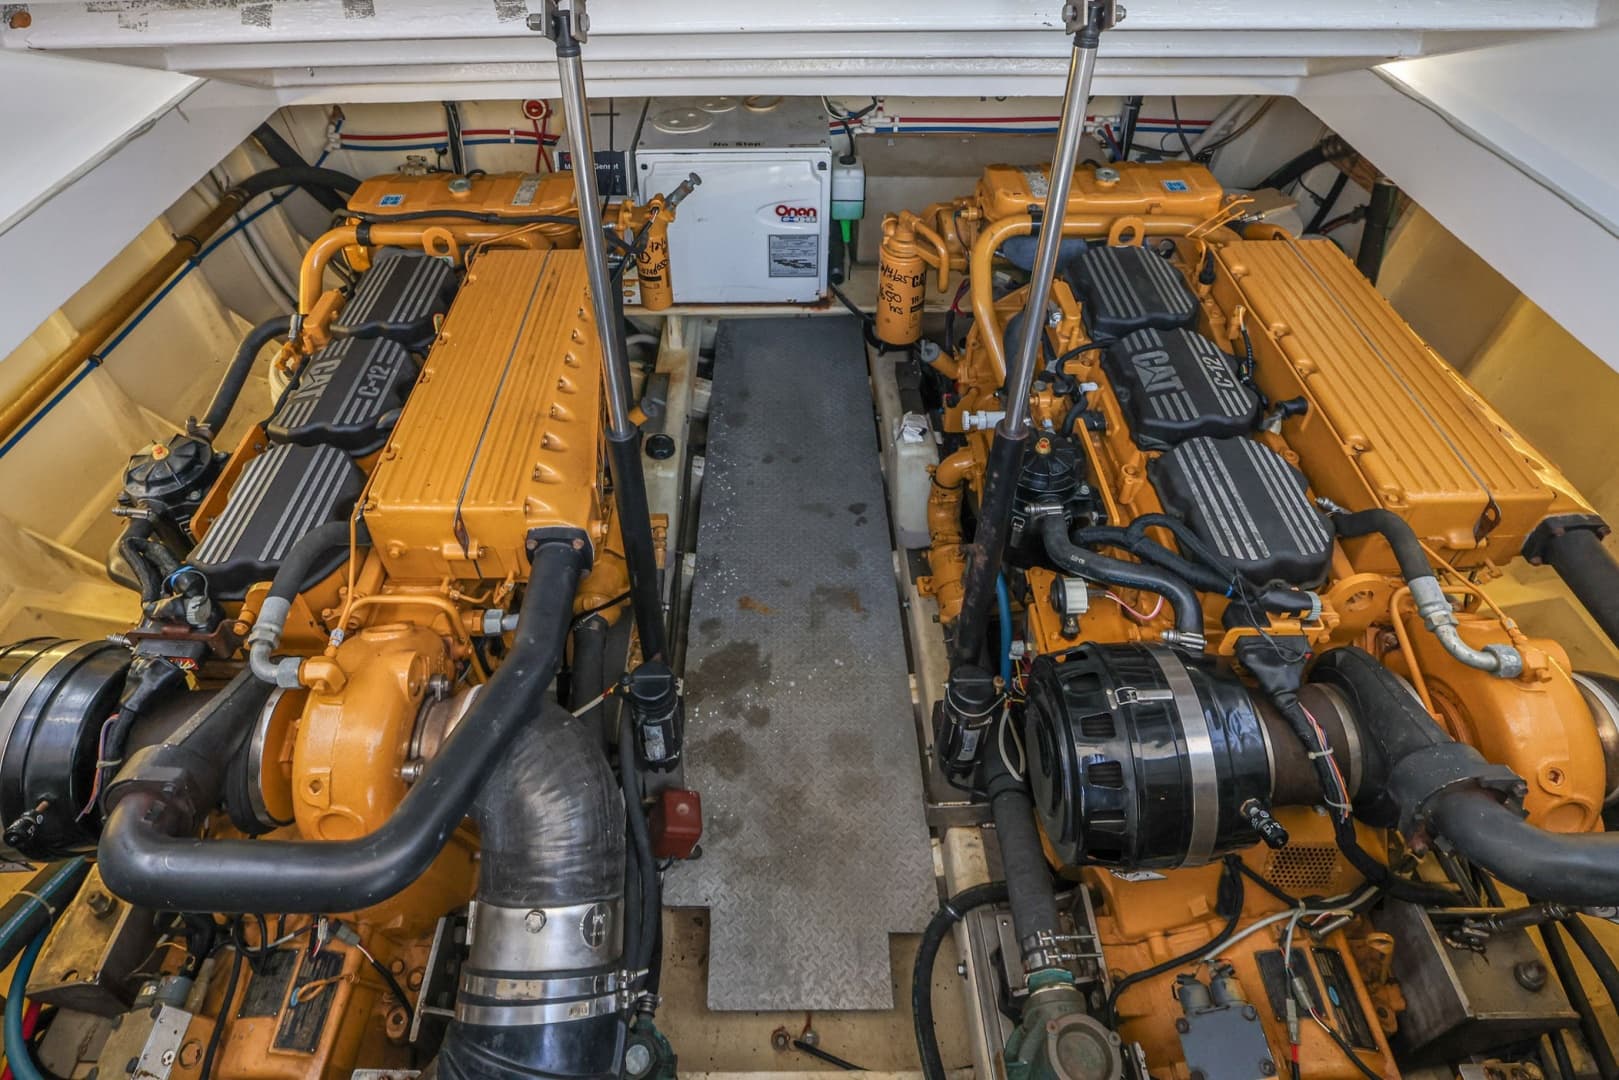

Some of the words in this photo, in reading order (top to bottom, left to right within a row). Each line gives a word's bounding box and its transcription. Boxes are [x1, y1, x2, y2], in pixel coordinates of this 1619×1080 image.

[775, 204, 817, 218] Onan
[293, 359, 342, 400] CAT
[357, 364, 392, 397] C-12
[1131, 350, 1185, 393] CAT
[1202, 356, 1235, 388] C-12
